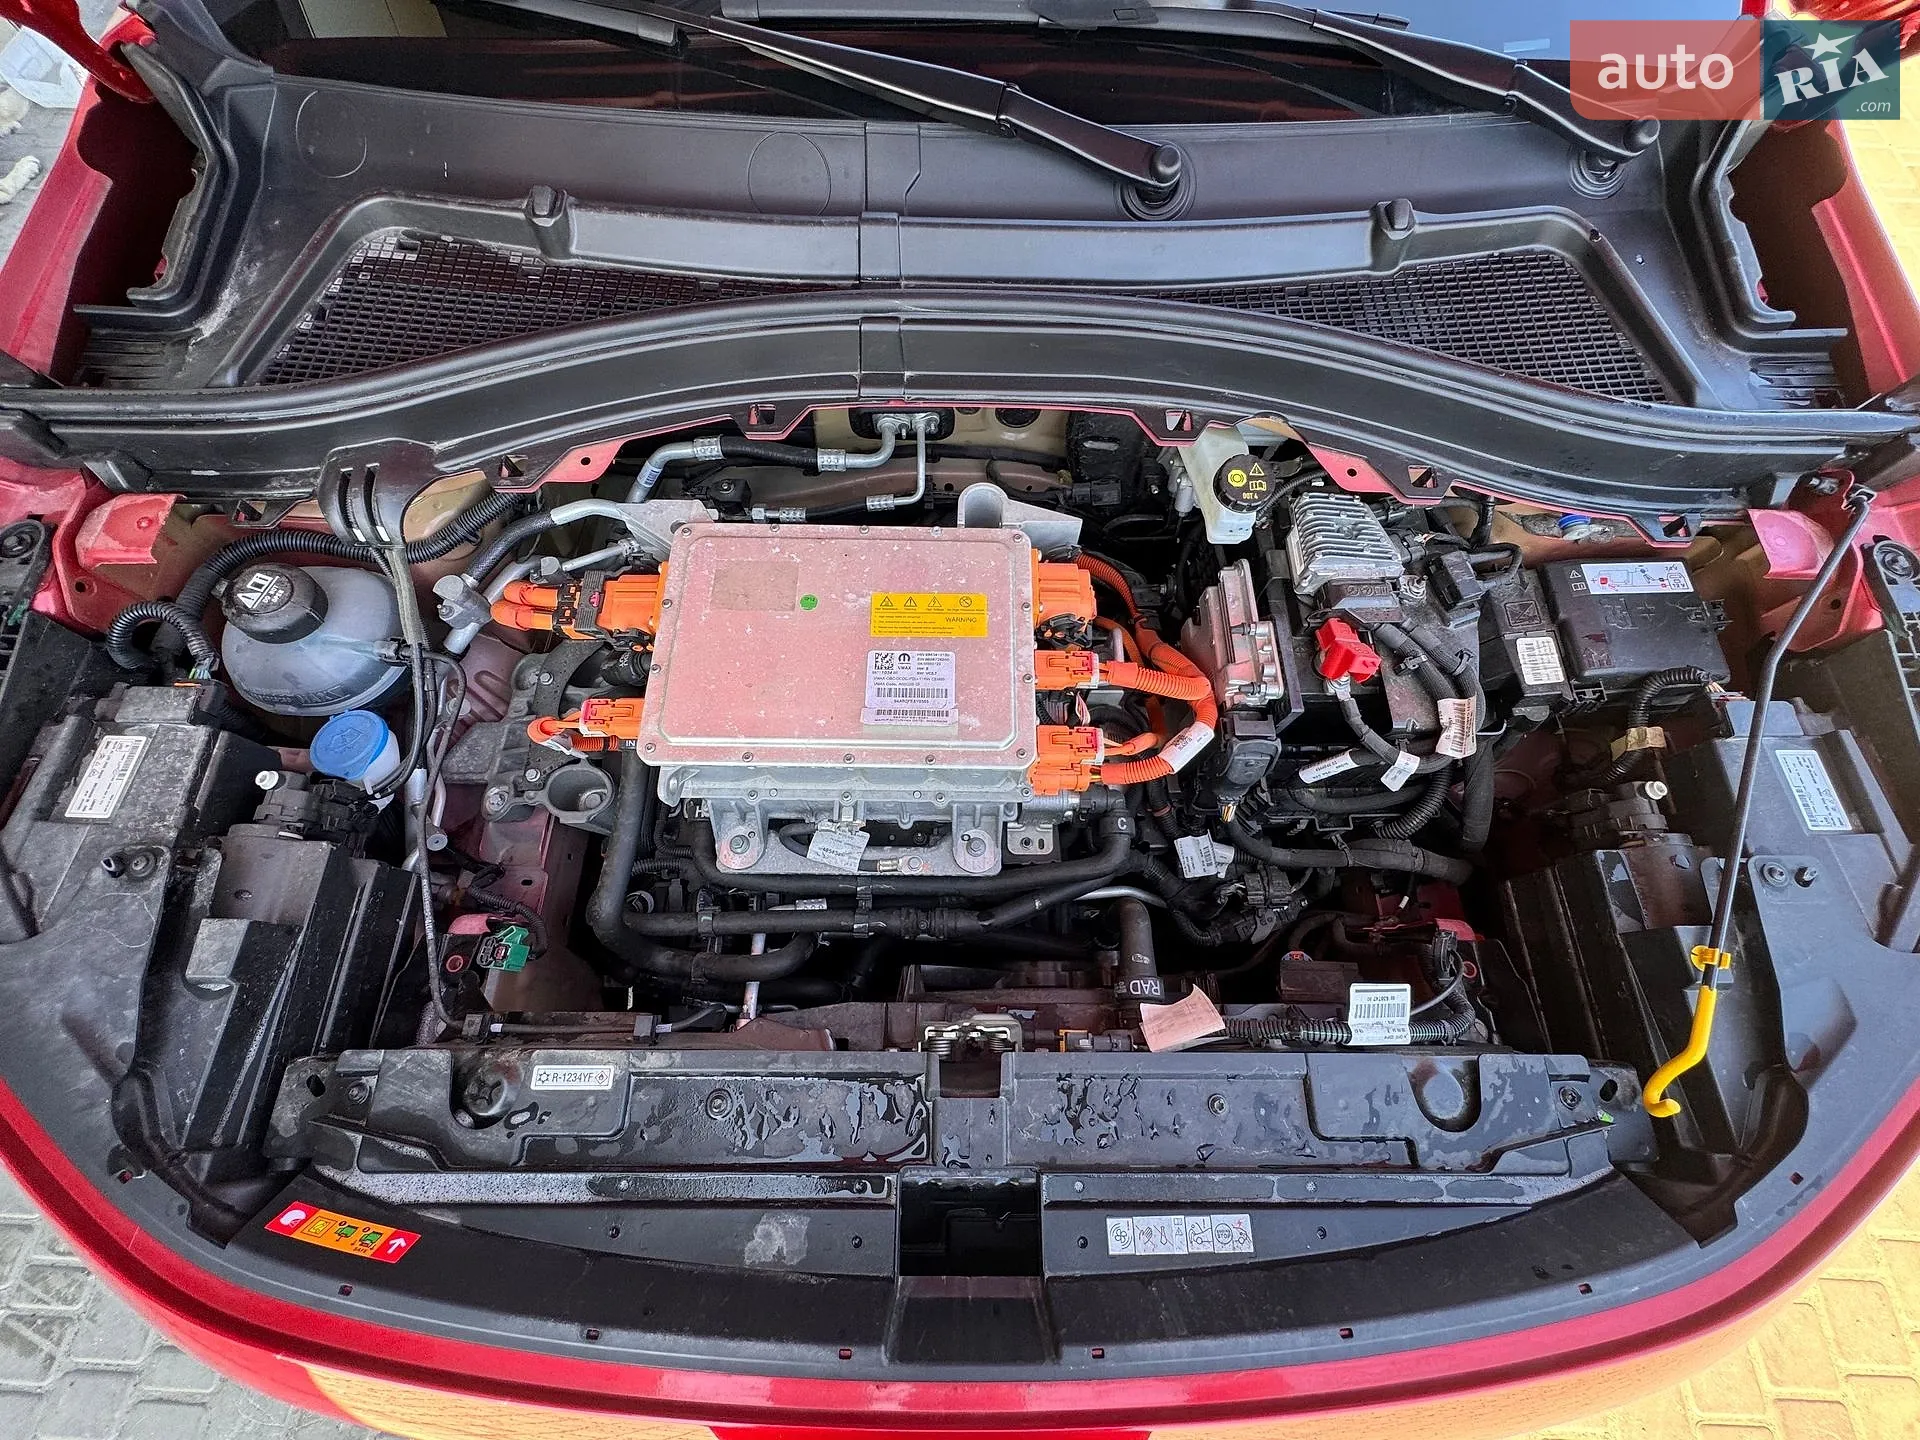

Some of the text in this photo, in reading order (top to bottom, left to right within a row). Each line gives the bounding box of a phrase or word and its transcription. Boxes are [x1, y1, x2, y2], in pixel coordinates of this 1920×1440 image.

[1117, 817, 1127, 830] C
[1129, 980, 1161, 996] RAD
[552, 1072, 594, 1083] R-1234YF
